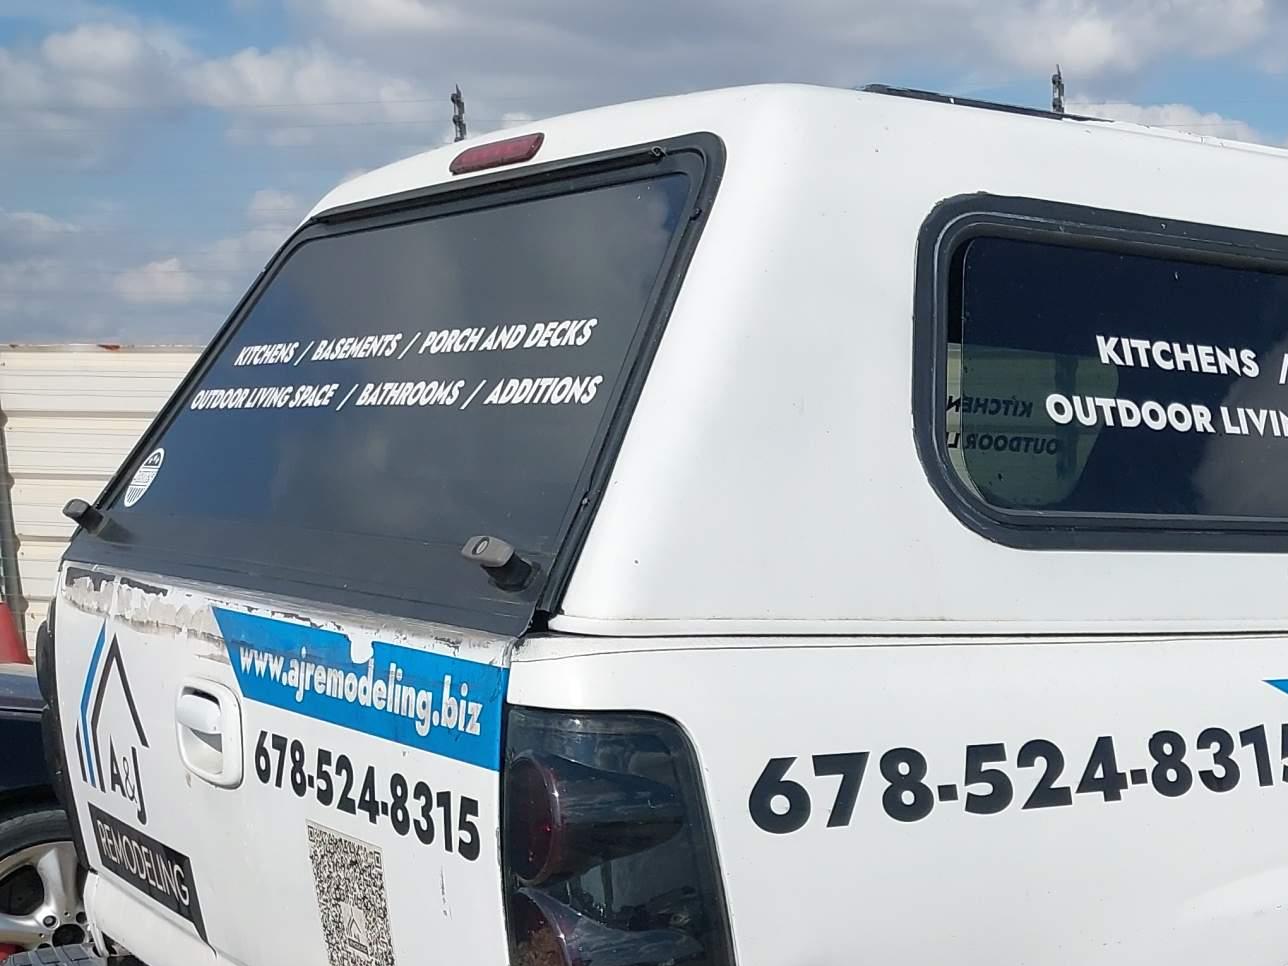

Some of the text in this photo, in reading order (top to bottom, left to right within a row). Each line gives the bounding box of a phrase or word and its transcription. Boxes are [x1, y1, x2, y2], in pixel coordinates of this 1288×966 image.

[234, 318, 598, 366] KITCHENS / BASEMENTS / PORCH AND DECKS
[1096, 335, 1260, 378] KITCHENS
[191, 375, 603, 411] OUTDOOR LIVING SPACE / BATHROOMS / ADDITIONS
[1045, 393, 1216, 433] OUTDOOR
[239, 646, 482, 737] www.ajremodeling.biz
[109, 734, 147, 825] A&J
[254, 731, 480, 862] 678-524-8315
[97, 820, 191, 906] REMODELING
